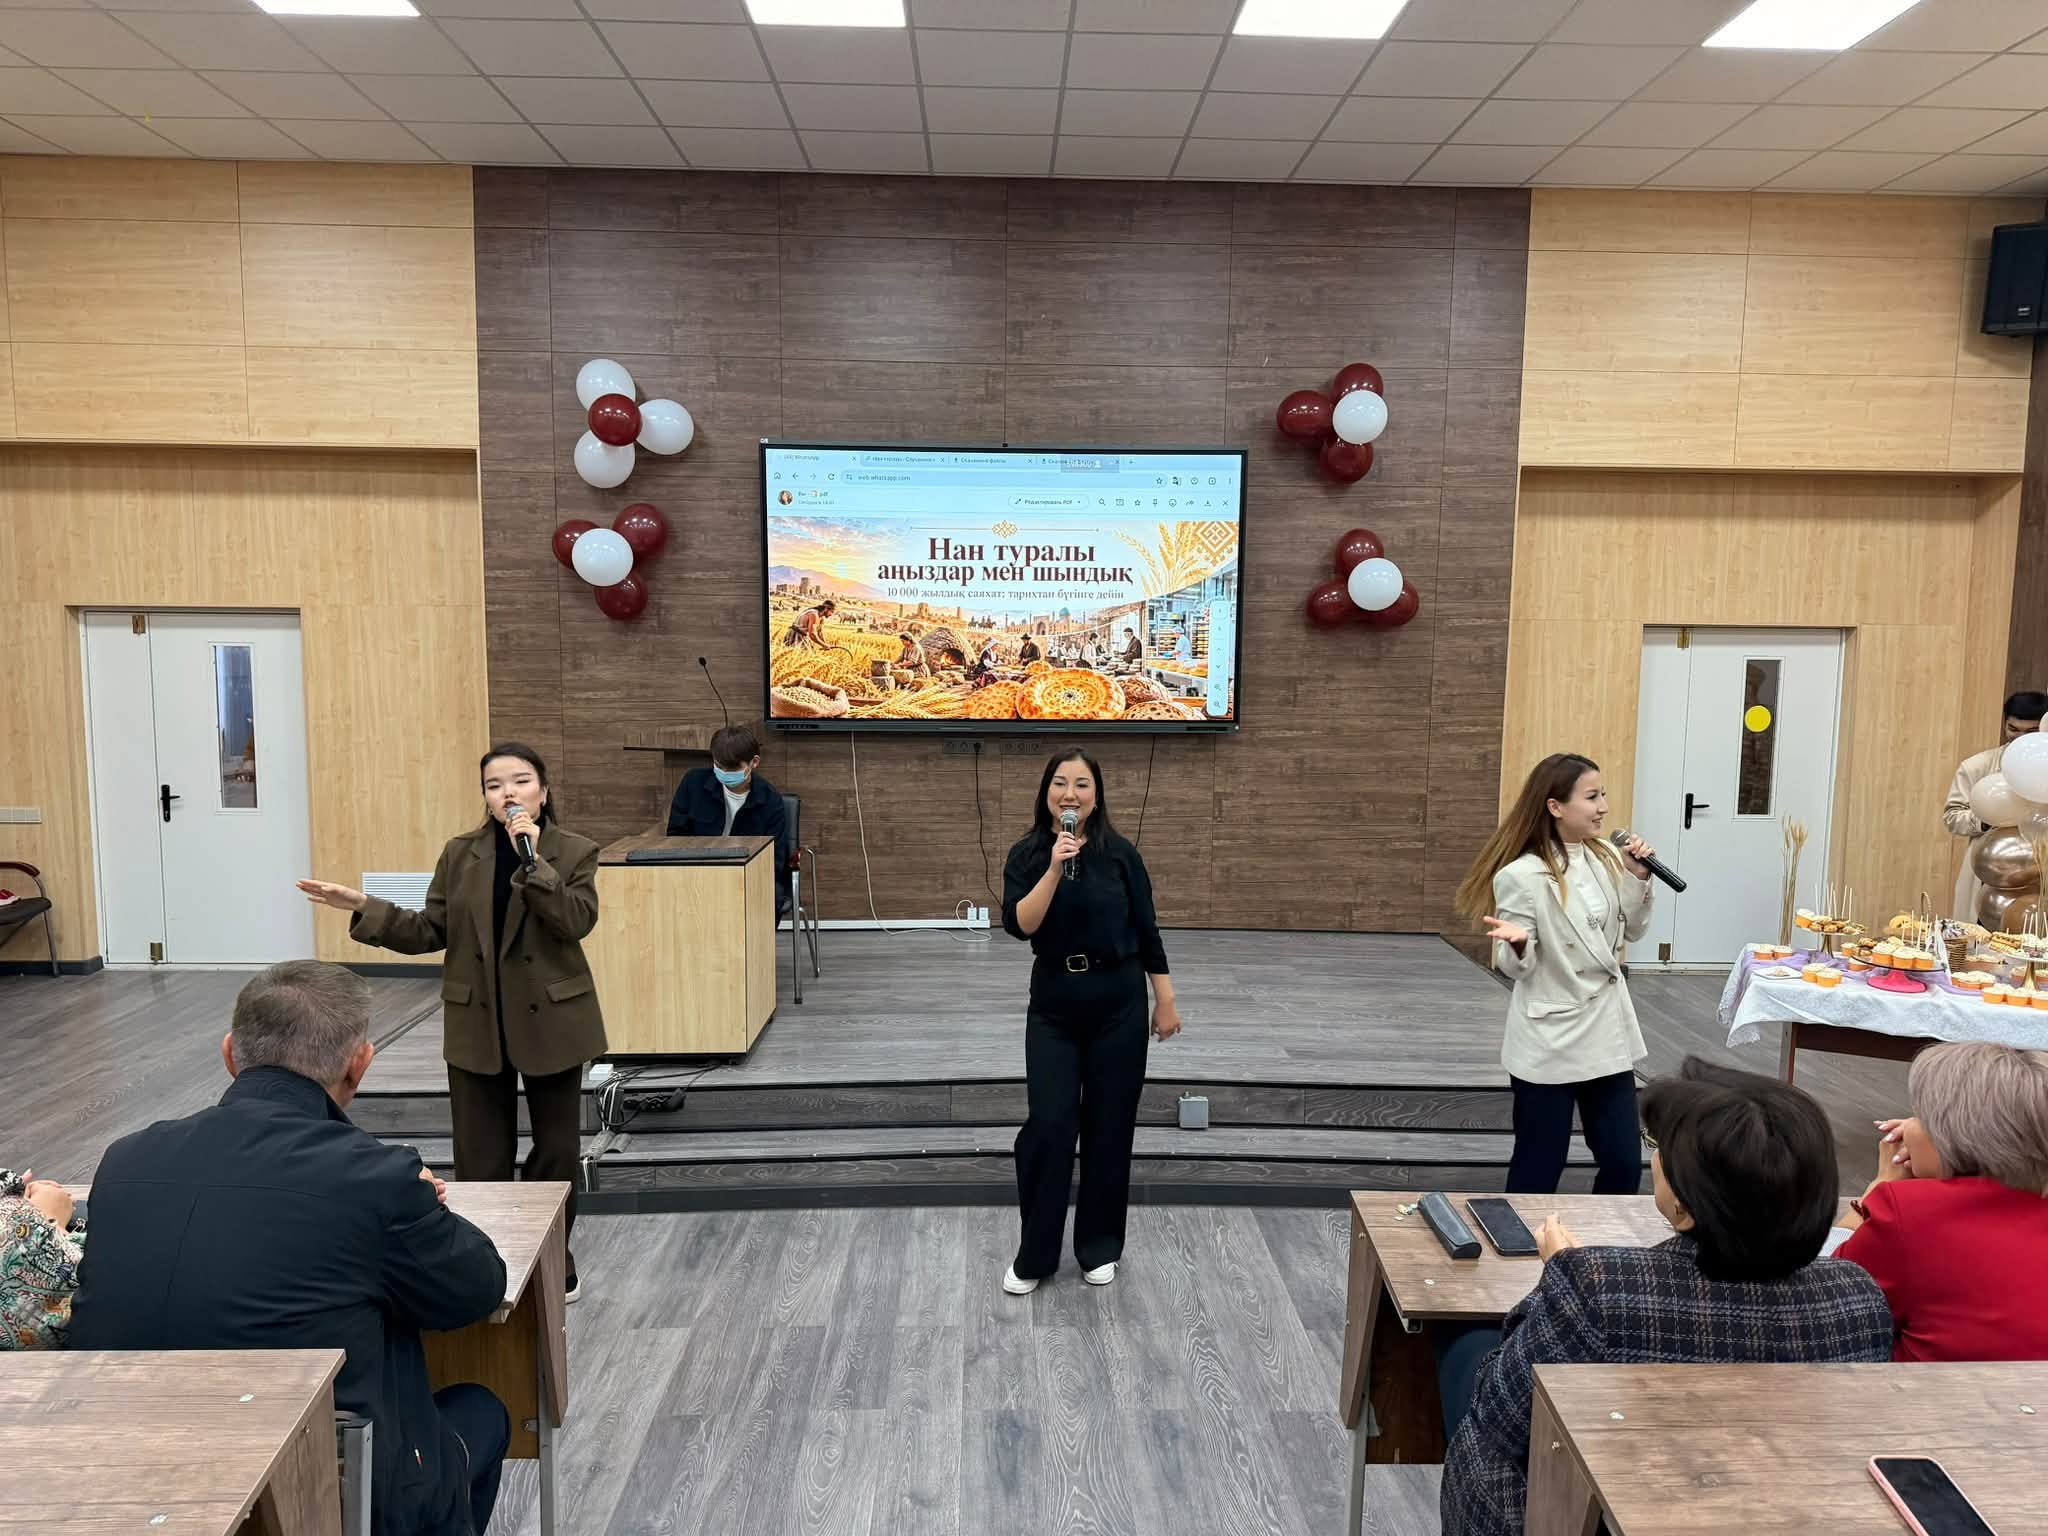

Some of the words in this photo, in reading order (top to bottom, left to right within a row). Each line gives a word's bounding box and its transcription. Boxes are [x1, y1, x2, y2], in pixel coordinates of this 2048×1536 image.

[928, 537, 985, 561] Нан
[993, 545, 1097, 567] туралы
[877, 564, 975, 587] аңыздар
[981, 565, 1025, 581] мен
[1032, 566, 1134, 586] шындық
[888, 587, 898, 597] 10
[899, 587, 919, 598] 000
[921, 589, 966, 600] жылдық
[1007, 590, 1055, 600] тарихтан
[1057, 588, 1094, 601] бүгінге
[1097, 589, 1125, 600] дейін
